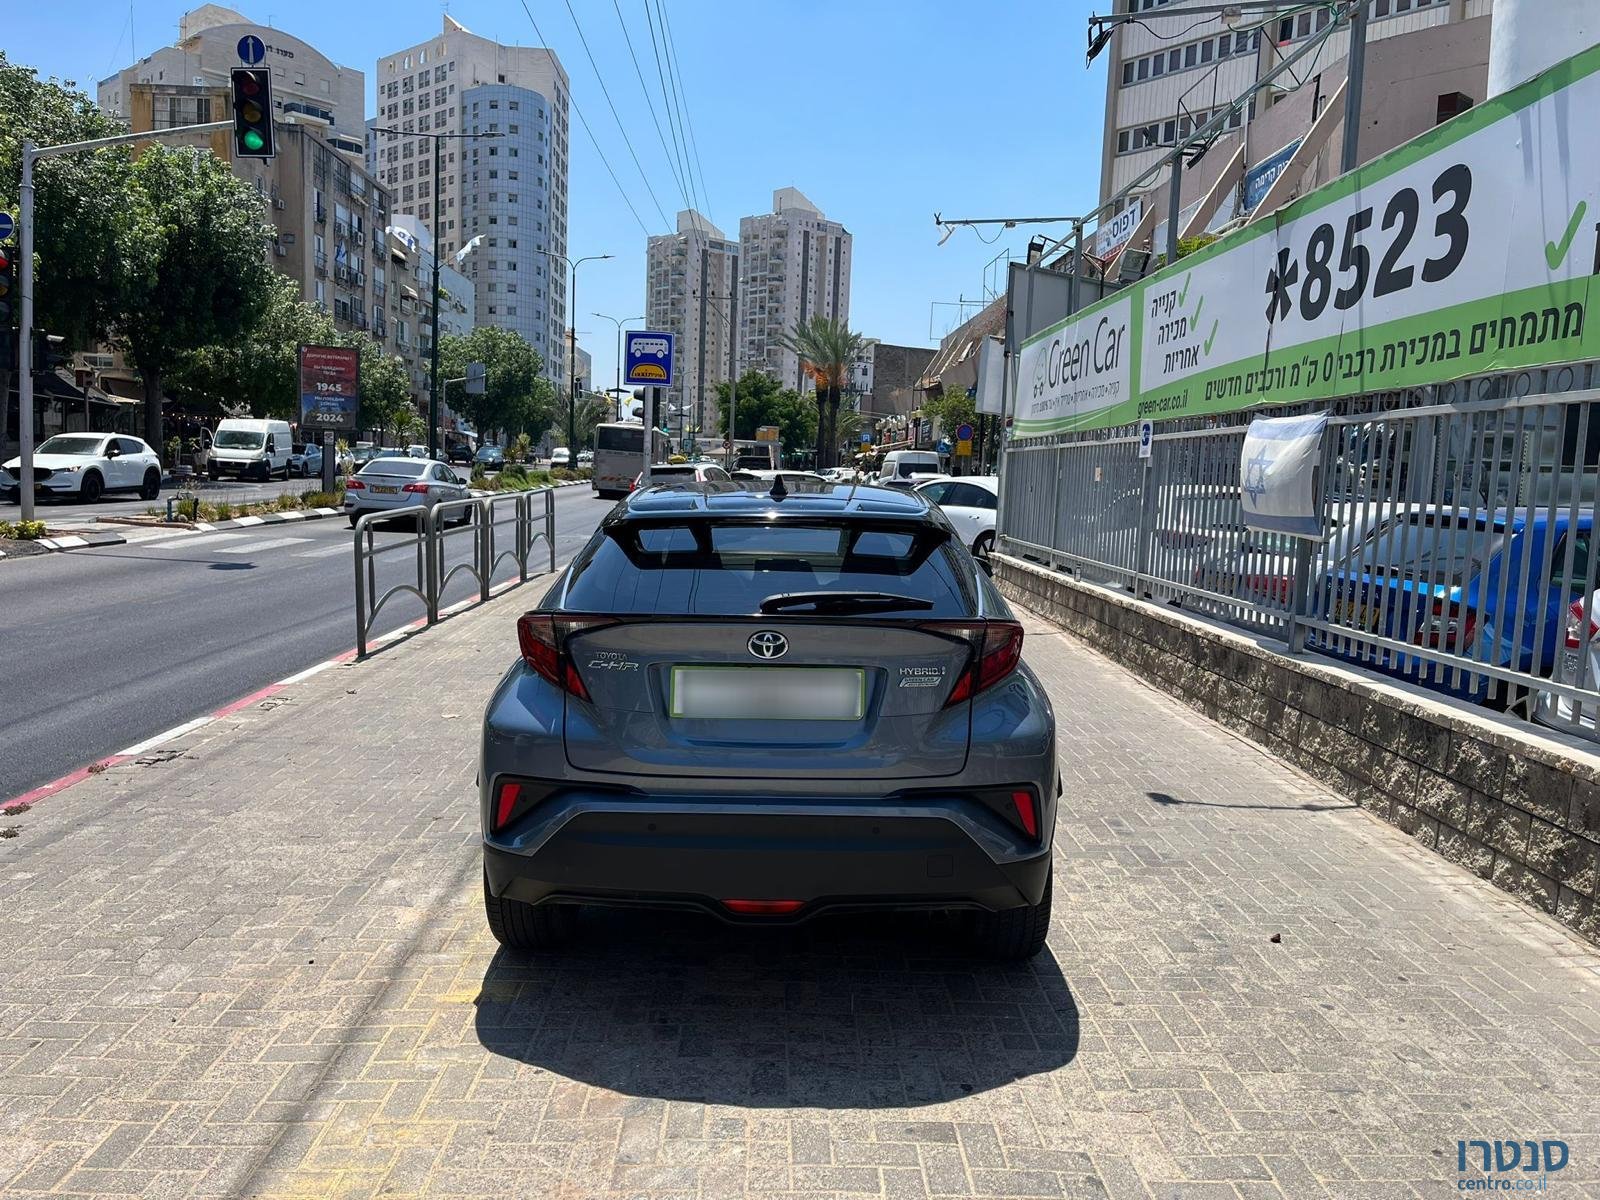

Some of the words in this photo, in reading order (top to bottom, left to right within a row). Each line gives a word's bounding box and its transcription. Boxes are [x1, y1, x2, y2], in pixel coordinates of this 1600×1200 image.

[1112, 208, 1136, 238] דפוס
[1151, 290, 1177, 318] קנייה
[1157, 317, 1187, 345] מכירה
[1469, 302, 1583, 355] מתמחים
[1048, 339, 1090, 389] Green
[1094, 316, 1126, 374] Car
[1163, 344, 1200, 374] אחריות
[1338, 347, 1375, 379] רכבי
[1379, 328, 1461, 372] במכירת
[1245, 366, 1286, 396] ורכבים
[1322, 351, 1334, 382] 0
[316, 382, 342, 392] 1945
[1204, 379, 1241, 401] חדשים
[316, 413, 344, 422] 2024
[1137, 388, 1188, 418] green-car.co.il
[587, 660, 640, 672] C-HR
[596, 651, 628, 660] TOYOTA
